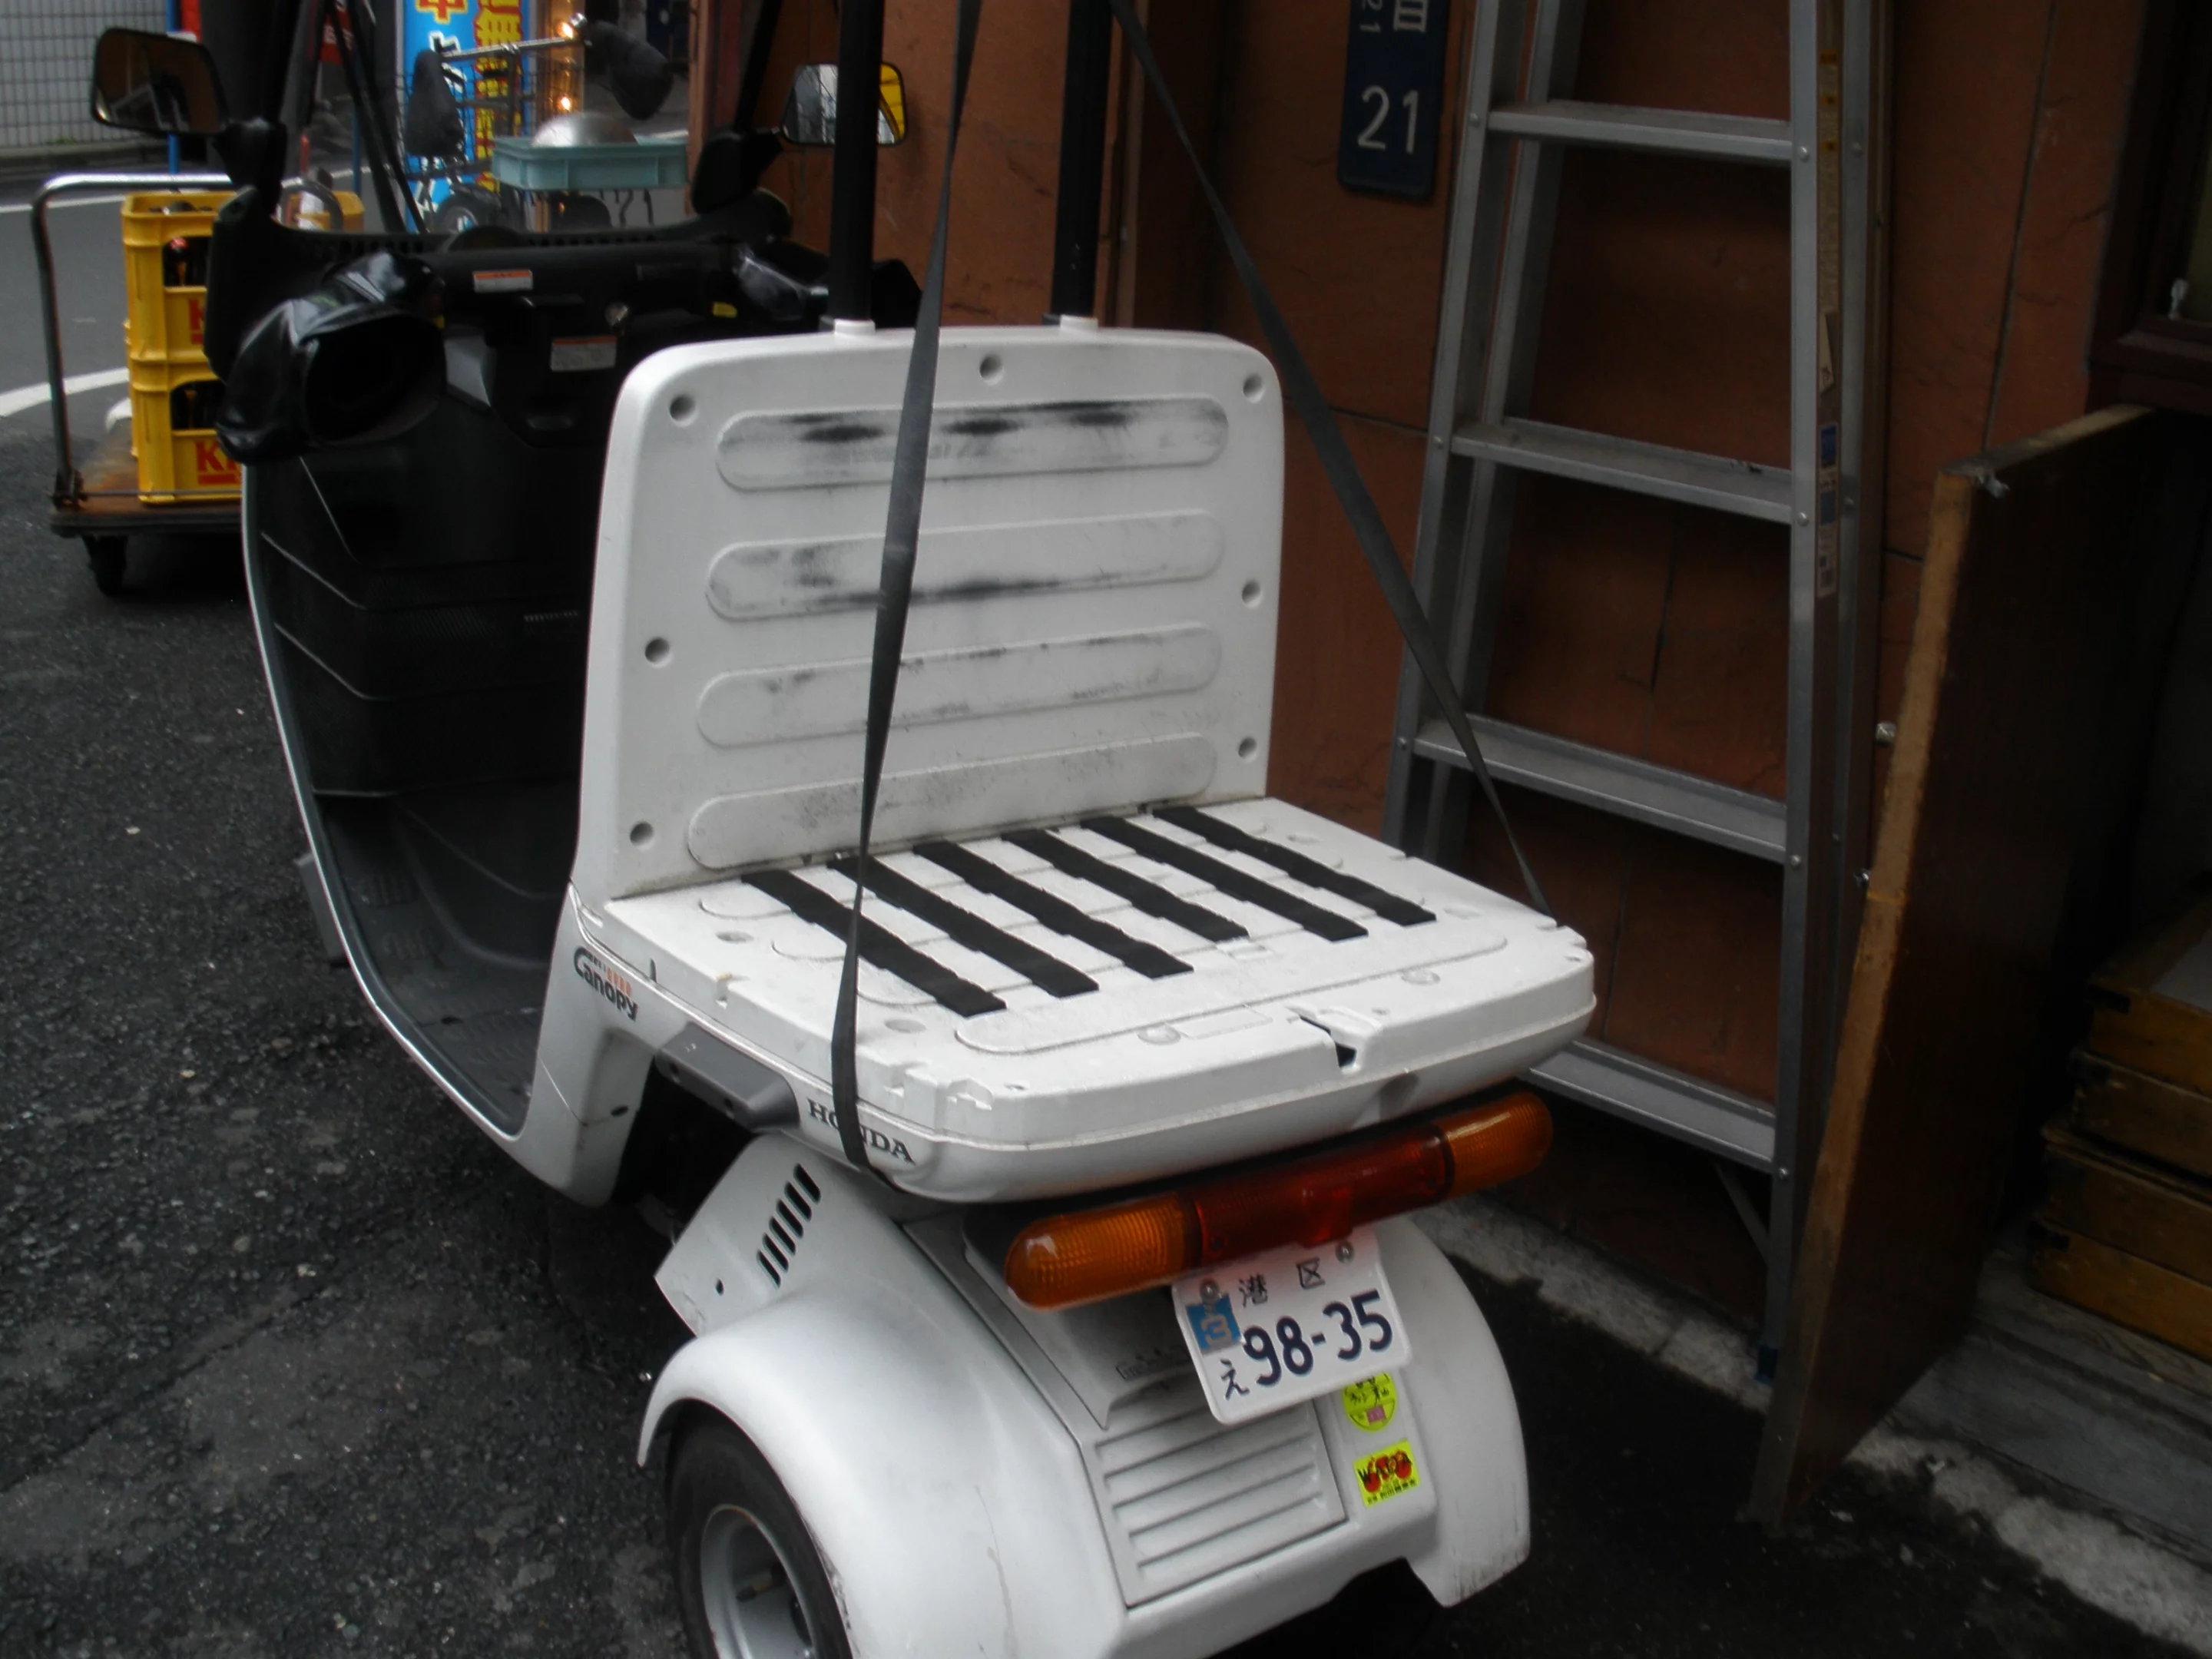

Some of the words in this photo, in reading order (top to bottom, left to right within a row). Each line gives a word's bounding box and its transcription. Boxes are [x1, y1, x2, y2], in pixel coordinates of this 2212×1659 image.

[1357, 84, 1419, 155] 21
[574, 946, 638, 1022] Canopy
[1220, 1358, 1250, 1400] え
[1243, 1290, 1392, 1386] 98-35
